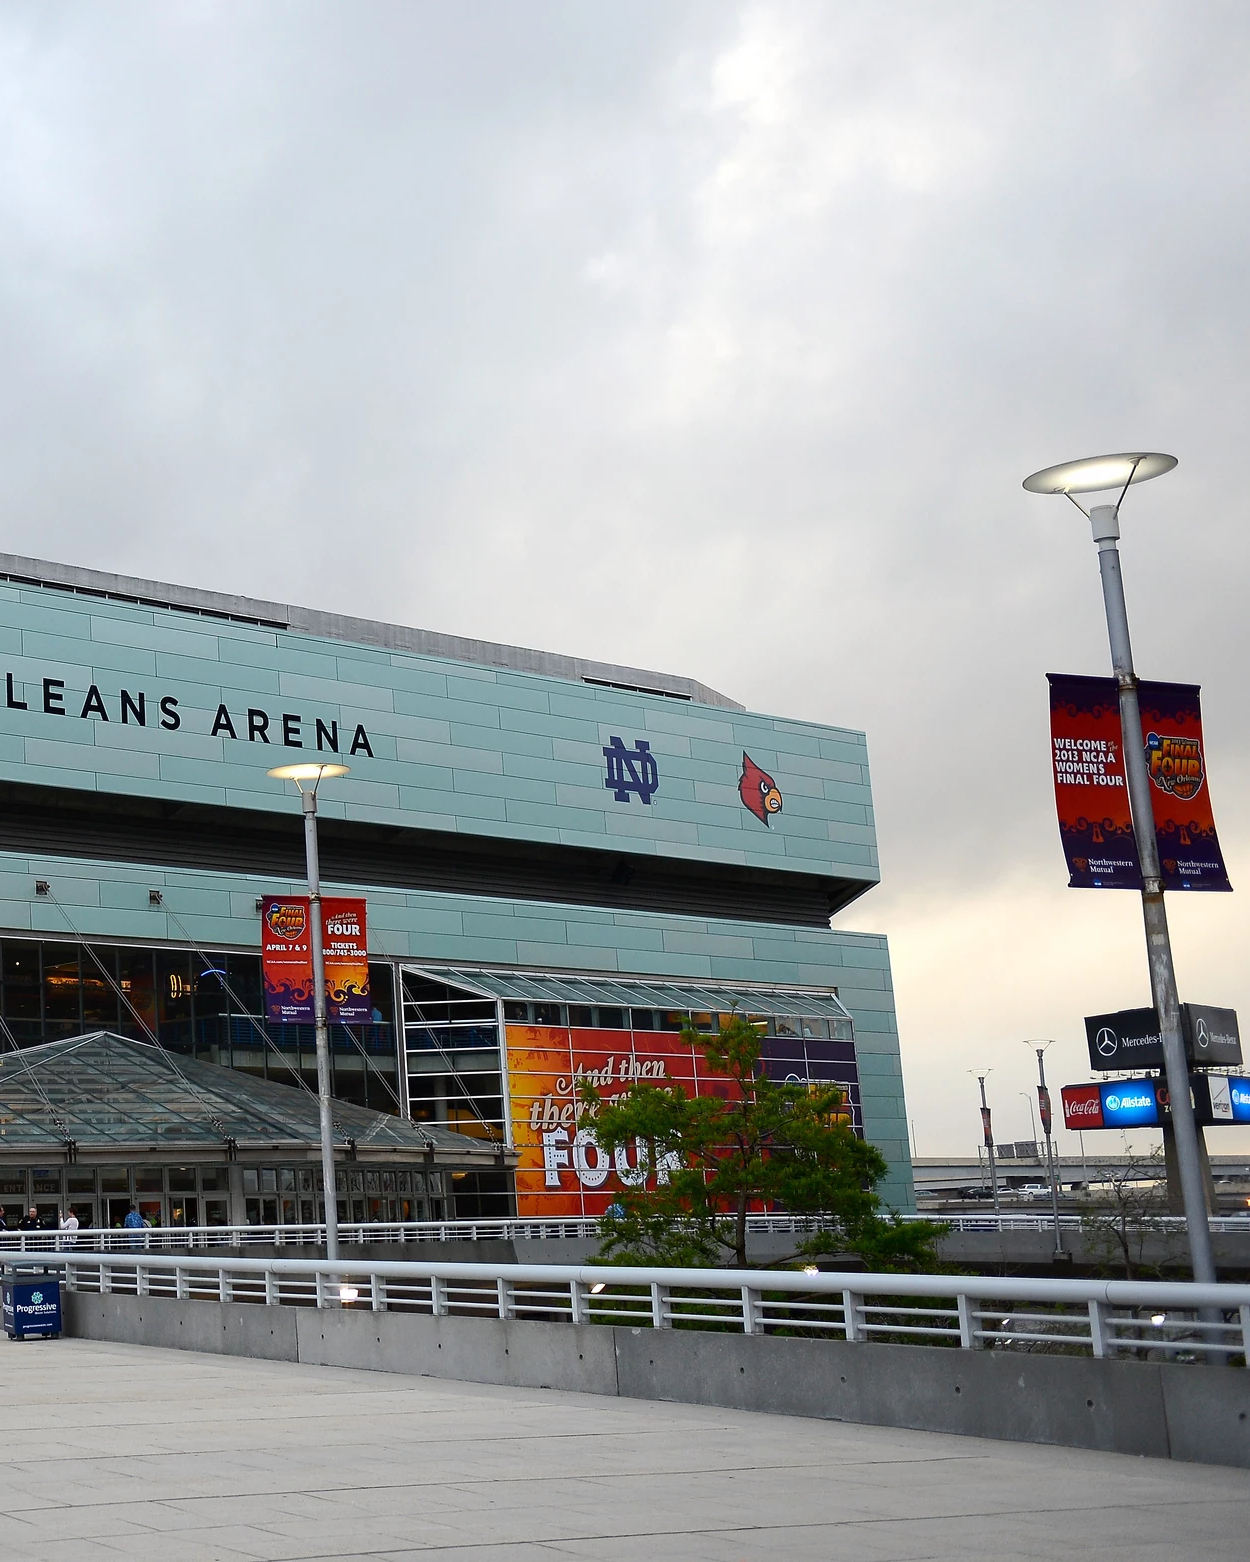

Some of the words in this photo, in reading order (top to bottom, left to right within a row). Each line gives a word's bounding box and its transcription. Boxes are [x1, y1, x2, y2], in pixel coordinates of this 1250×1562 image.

[211, 703, 374, 758] ARENA
[1053, 738, 1107, 751] WELCOME
[1162, 739, 1199, 758] FINAL
[1054, 750, 1079, 761] 2013
[1082, 751, 1116, 763] NCAA
[1055, 761, 1105, 774] WOMEN'S
[1151, 750, 1201, 777] FOUR
[1057, 773, 1090, 785] FINAL
[1093, 774, 1124, 786] FOUR
[1088, 858, 1134, 867] Northwestern
[1177, 860, 1219, 869] Northwestern
[1090, 866, 1114, 874] Mutual
[280, 907, 303, 917] FINAL
[270, 913, 304, 927] FOUR
[327, 924, 361, 936] FOUR
[266, 944, 287, 952] APRIL
[330, 942, 357, 950] TICKETS
[1121, 1032, 1163, 1048] Mercedes-
[556, 1055, 614, 1095] And
[618, 1054, 666, 1083] then
[1120, 1095, 1152, 1109] Allstate
[3, 1183, 55, 1193] ENTANCE
[16, 1303, 57, 1314] Progressive
